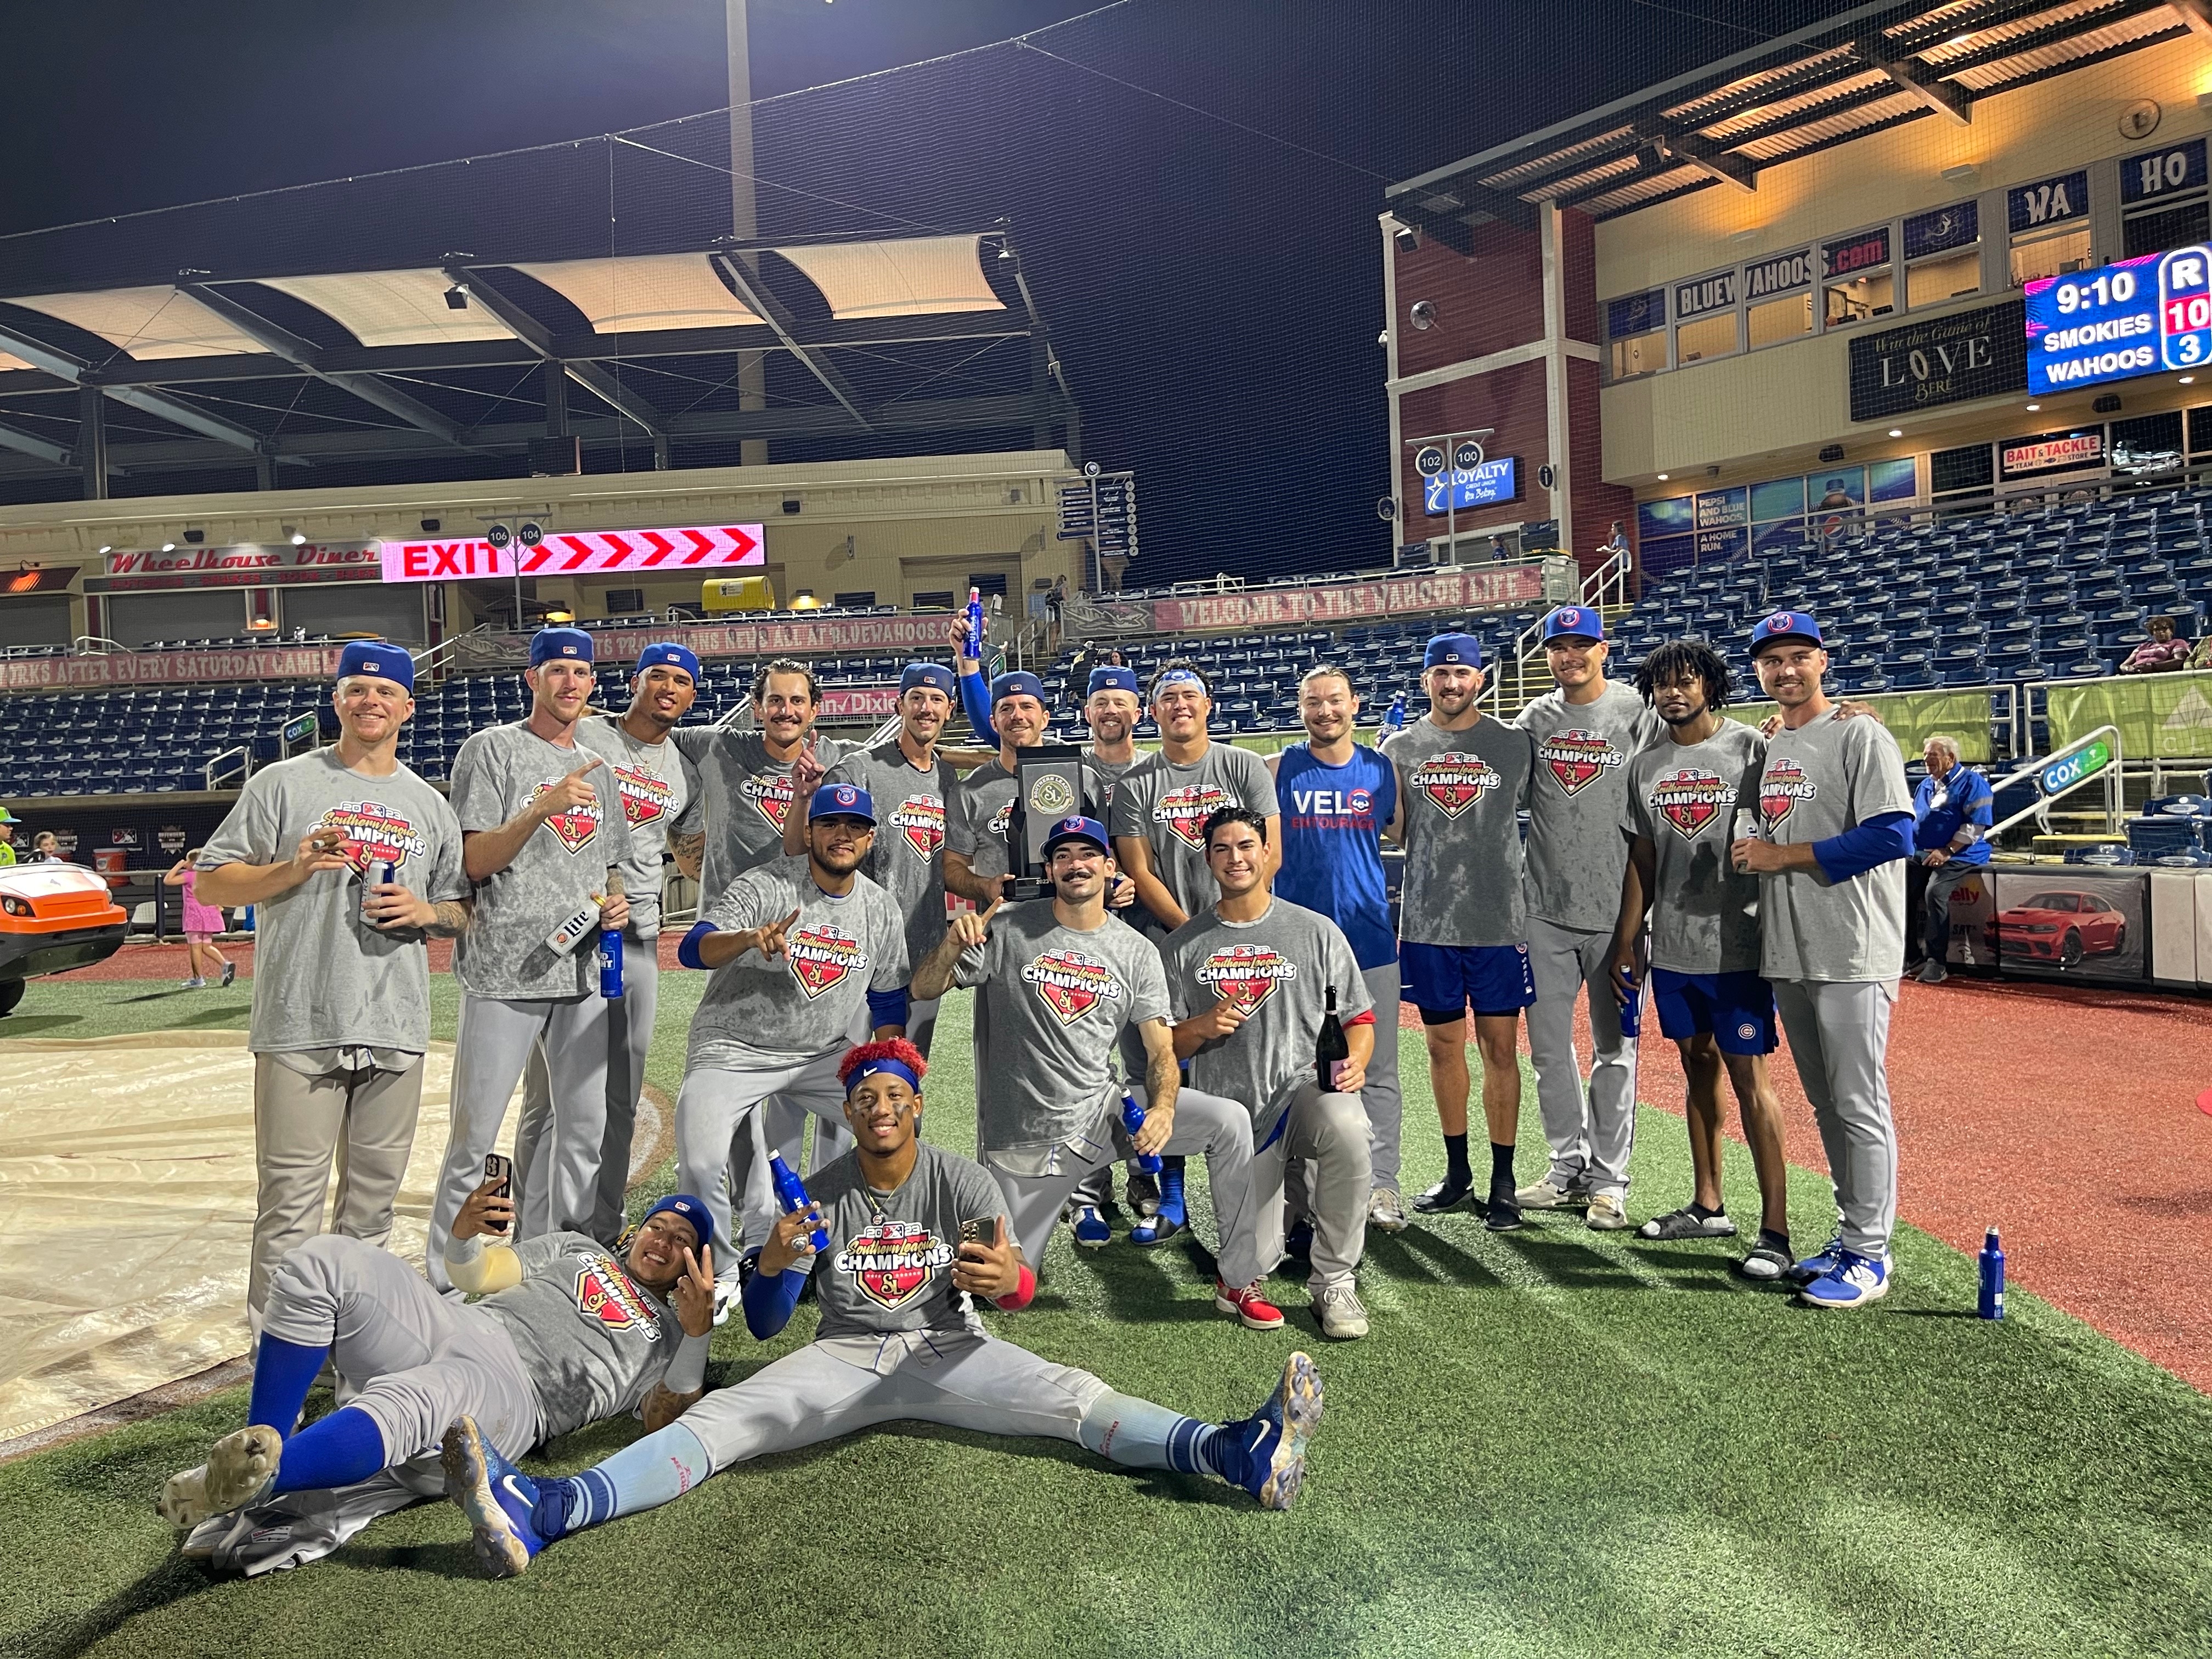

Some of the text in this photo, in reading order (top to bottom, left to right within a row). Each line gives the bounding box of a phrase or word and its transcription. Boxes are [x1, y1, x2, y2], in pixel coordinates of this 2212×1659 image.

[2024, 151, 2187, 224] WA HO
[2171, 258, 2203, 290] R
[2056, 272, 2135, 314] 9:10
[2168, 298, 2209, 330] 10
[1907, 331, 1928, 347] the
[1932, 323, 1972, 340] Game
[1976, 315, 1991, 331] of
[2044, 313, 2152, 352] SMOKIES
[2179, 334, 2200, 363] 3
[1878, 336, 1993, 388] LOVE
[2046, 346, 2153, 383] WAHOOS
[1458, 451, 1477, 462] 100
[2006, 447, 2037, 462] BAIT
[2045, 437, 2097, 456] TACKLE
[2068, 452, 2088, 460] STORE
[1421, 456, 1440, 467] 102
[1699, 496, 1725, 507] PEPSI
[1700, 503, 1745, 517] AND BLUE
[1700, 513, 1745, 527] WAHOOS.
[490, 532, 507, 541] 106
[522, 530, 539, 539] 104
[1700, 530, 1737, 543] A HOME
[1701, 542, 1723, 552] RUN.
[110, 544, 379, 574] Wheelhouse Diner
[404, 542, 498, 577] EXIT
[1180, 572, 1518, 625] WELCOME TO THE WAHOOS LIFE
[832, 621, 951, 646] BLUEWAHOOS.C
[57, 659, 110, 683] AFTER
[116, 656, 171, 680] EVERY
[177, 652, 267, 678] SATURDAY
[851, 692, 898, 713] Dixie
[287, 725, 303, 738] COX
[1538, 748, 1622, 765] CHAMPIONS
[1544, 739, 1614, 757] Southern League
[621, 763, 634, 773] 20
[1418, 764, 1491, 778] Southern League
[1564, 764, 1580, 782] SL
[2046, 758, 2081, 788] COX
[645, 781, 674, 798] League
[1034, 776, 1070, 799] SOUTHERN LEAGUE
[1411, 774, 1500, 787] CHAMPIONS
[1653, 781, 1729, 796] Southern League
[618, 781, 679, 812] AMPIONS
[1044, 785, 1060, 802] SL
[1158, 794, 1229, 810] Southern League
[1444, 787, 1461, 804] SL
[1647, 791, 1739, 806] CHAMPIONS
[342, 803, 402, 819] 20 23
[899, 804, 932, 817] Southern
[1680, 806, 1697, 825] SL
[322, 811, 419, 839] Southern League
[563, 817, 582, 839] SL
[890, 814, 945, 831] CHAMPIO
[1291, 816, 1376, 830] ENTOURAGE
[309, 823, 425, 855] CAMPIONS
[1949, 887, 1979, 904] elly
[562, 911, 589, 938] Lite
[807, 925, 851, 940] 20 23
[791, 932, 862, 958] Southern League
[787, 943, 868, 969] HAMPIONS
[1049, 950, 1098, 966] 20 23
[1206, 956, 1285, 970] Southern League
[808, 963, 825, 985] SL
[1033, 957, 1113, 985] Southern League
[1197, 965, 1295, 981] CHAMPIONS
[1022, 966, 1120, 998] CHAMPIONS
[1059, 990, 1075, 1012] SL
[866, 1224, 921, 1238] 20 23
[847, 1238, 938, 1257] Southern League
[837, 1246, 952, 1271] CHAMPIONS
[594, 1254, 634, 1305] Southern
[881, 1273, 905, 1295] SL
[579, 1253, 661, 1342] CHAMPIONS
